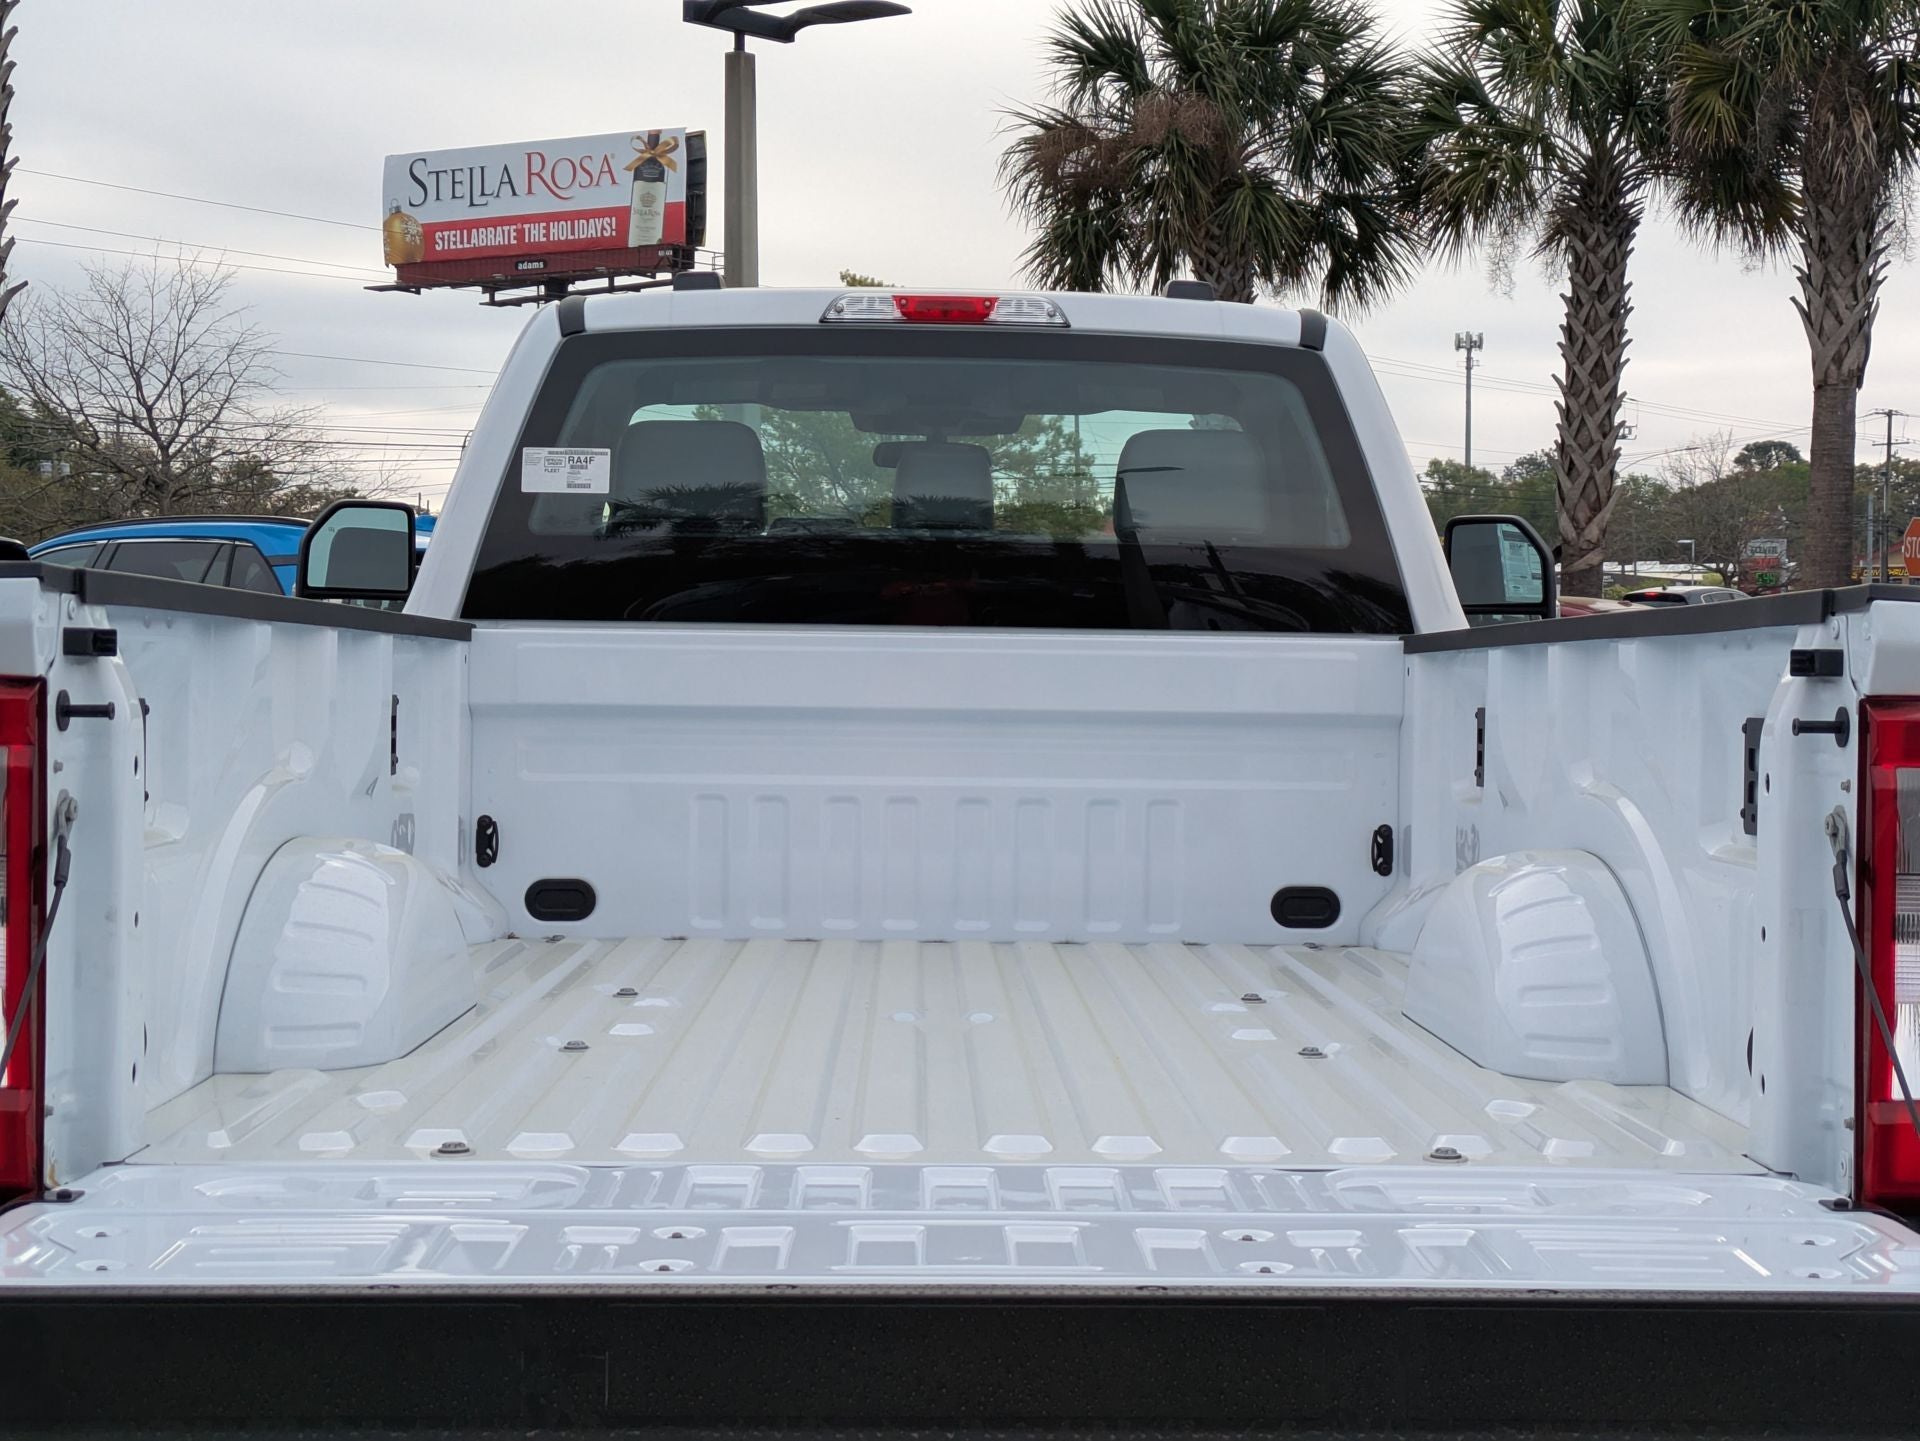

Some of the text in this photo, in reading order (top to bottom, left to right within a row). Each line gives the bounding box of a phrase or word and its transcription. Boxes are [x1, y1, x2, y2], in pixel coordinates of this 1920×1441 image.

[408, 151, 619, 207] STELLA ROSA
[523, 222, 548, 243] THE
[549, 217, 616, 241] HOLIDAYS!
[518, 261, 544, 270] adams
[568, 456, 595, 464] RA4F
[1905, 537, 1920, 558] STO
